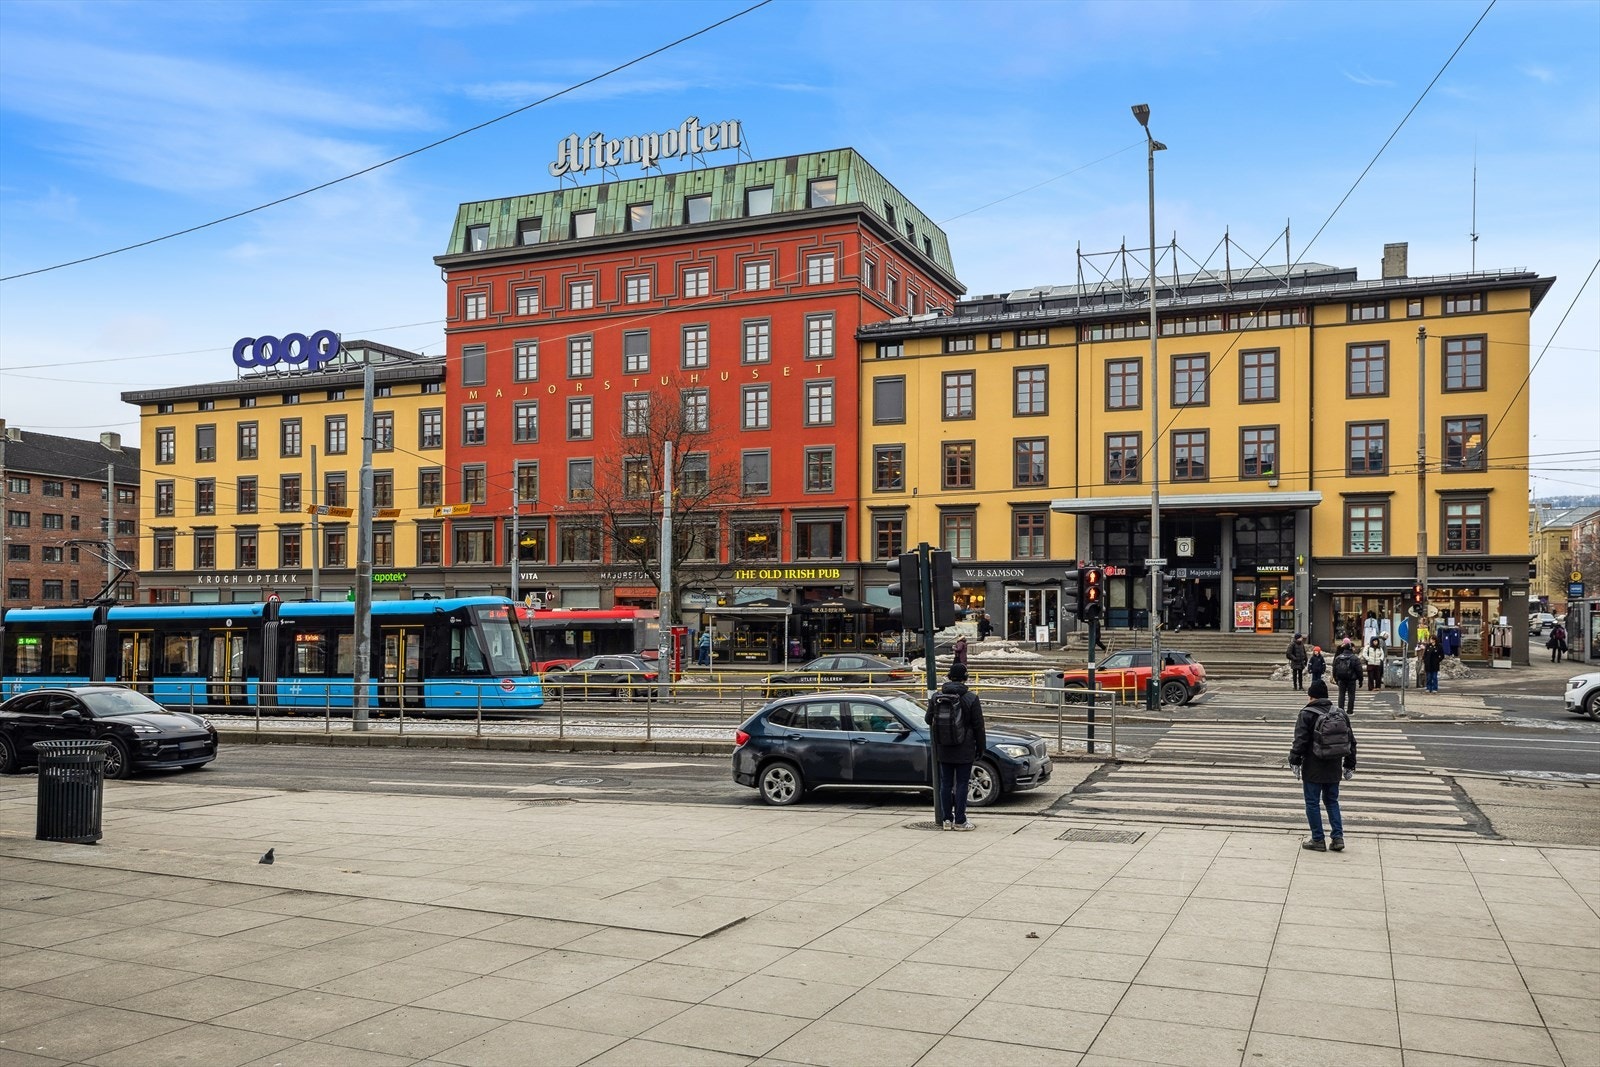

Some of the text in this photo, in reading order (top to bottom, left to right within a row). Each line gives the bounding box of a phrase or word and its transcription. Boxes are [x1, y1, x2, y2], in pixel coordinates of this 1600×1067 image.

[548, 115, 741, 177] Aftenposten
[232, 329, 341, 371] coop
[469, 363, 823, 400] MAJORSTUHUSET
[1436, 563, 1492, 572] CHANGE
[735, 569, 841, 579] THE OLD IRISH PUB
[986, 569, 1025, 577] SAMSON
[198, 574, 298, 583] KROGH OPTIKK
